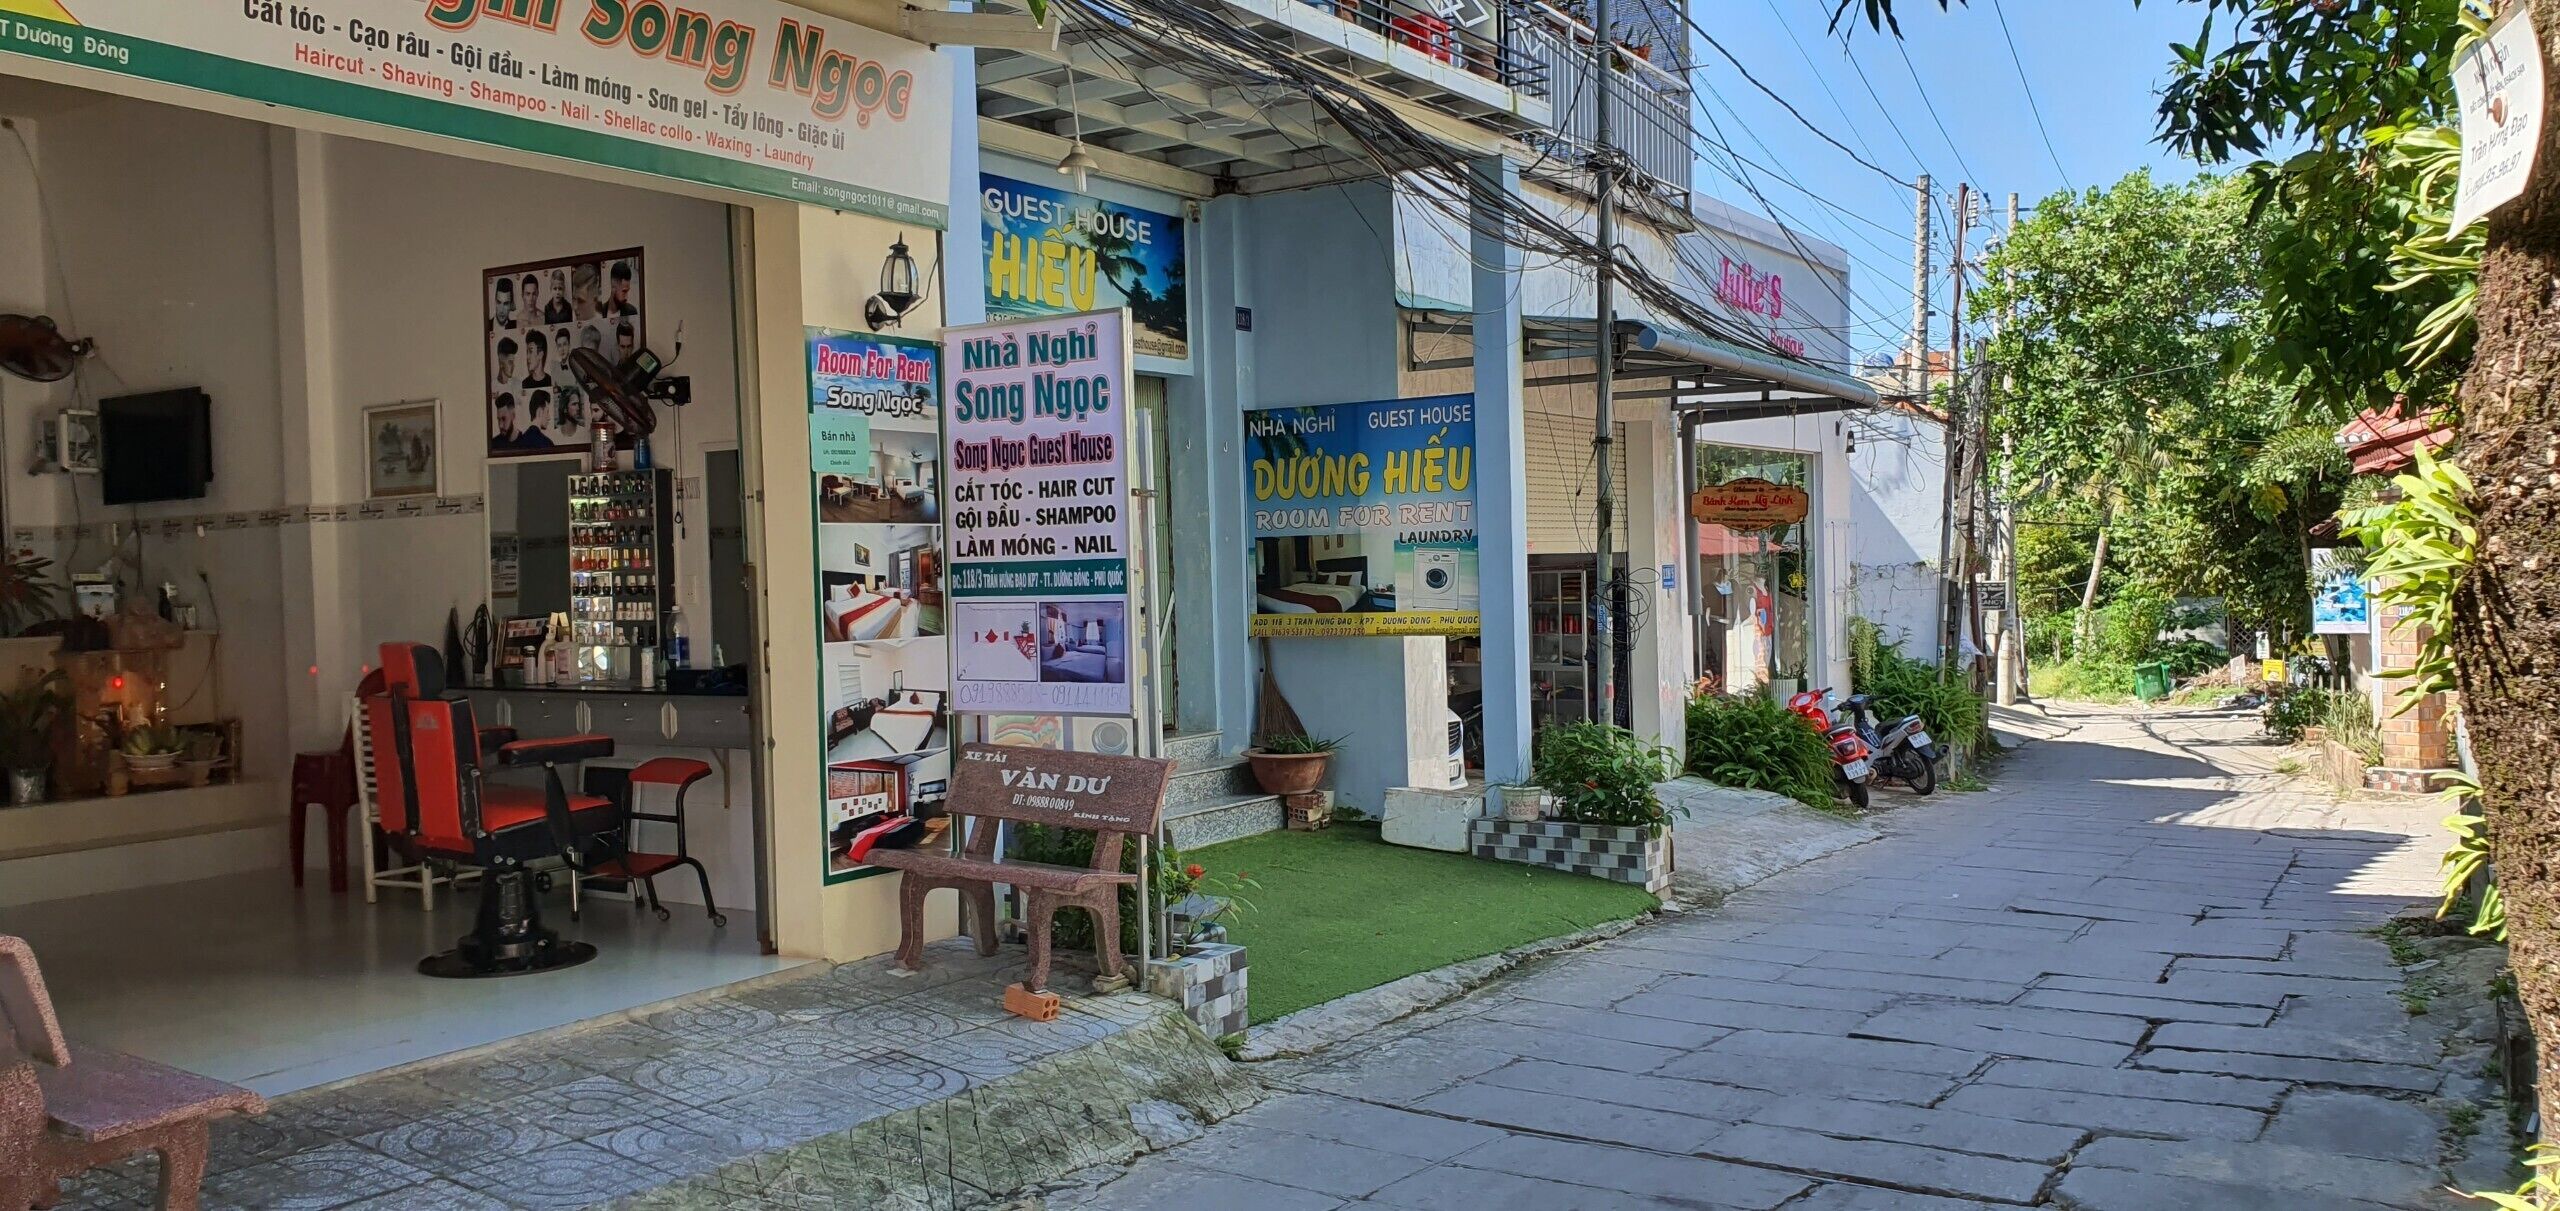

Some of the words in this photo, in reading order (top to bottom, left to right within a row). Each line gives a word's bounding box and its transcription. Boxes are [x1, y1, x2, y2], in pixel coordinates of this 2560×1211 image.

[15, 22, 73, 53] Dương
[84, 36, 129, 65] Đông
[290, 6, 326, 36] tóc
[349, 18, 390, 51] Cạo
[397, 32, 430, 59] râu
[451, 42, 483, 73] Gội
[488, 50, 523, 79] đầu
[541, 62, 578, 92] Làm
[585, 77, 631, 105] móng
[649, 87, 679, 113] Sơn
[683, 97, 707, 119] gel
[723, 103, 748, 130] Tẩy
[753, 111, 783, 138] lông
[798, 122, 828, 148] Giặc
[832, 127, 845, 150] ủi
[580, 0, 756, 96] Song
[768, 17, 913, 129] Ngọc
[295, 43, 364, 75] Haircut
[382, 62, 453, 97] Shaving
[470, 80, 546, 113] Shampoo
[561, 100, 590, 122] Nail
[604, 110, 656, 135] Shellac
[660, 122, 693, 143] collo
[706, 131, 752, 157] Waxing
[764, 144, 814, 171] Laundry
[791, 177, 821, 194] Email:
[823, 185, 895, 210] songngoc1011@
[897, 202, 939, 219] gmail.com
[984, 187, 1065, 225] GUEST
[1075, 207, 1152, 245] HOUSE
[989, 223, 1096, 312] HIẾU
[962, 331, 1021, 372] Nhà
[1027, 322, 1098, 367] Nghỉ
[817, 344, 862, 377] Room
[866, 349, 893, 379] For
[895, 354, 931, 383] Rent
[827, 386, 876, 415] Song
[877, 389, 923, 417] Ngọc
[954, 374, 1026, 425] Song
[1033, 371, 1112, 422] Ngọc
[1250, 414, 1286, 437] NHÀ
[1293, 408, 1335, 434] NGHỈ
[1368, 408, 1415, 429] GUEST
[1420, 404, 1472, 426] HOUSE
[821, 430, 837, 441] Bán
[840, 431, 856, 441] nhà
[954, 437, 988, 472] Song
[990, 435, 1026, 471] Ngoc
[1029, 433, 1068, 467] Guest
[1070, 432, 1114, 465] House
[1254, 446, 1371, 501] DƯƠNG
[1383, 426, 1471, 495] HIẾU
[954, 476, 985, 503] CẮT
[990, 477, 1023, 500] TÓC
[1038, 479, 1078, 499] HAIR
[1083, 476, 1116, 498] CUT
[1703, 495, 1727, 506] Bánh
[955, 507, 982, 531] GỘI
[987, 502, 1020, 529] ĐẦU
[1035, 505, 1117, 526] SHAMPOO
[1255, 507, 1330, 532] ROOM
[1338, 504, 1392, 528] FOR
[1399, 500, 1473, 526] RENT
[956, 535, 995, 558] LÀM
[1001, 534, 1056, 556] MÓNG
[1074, 535, 1118, 554] NAIL
[1399, 528, 1474, 545] LAUNDRY
[963, 568, 983, 589] 118/3
[964, 751, 981, 761] XE
[1000, 766, 1061, 791] VĂN
[1065, 774, 1111, 795] DƯ
